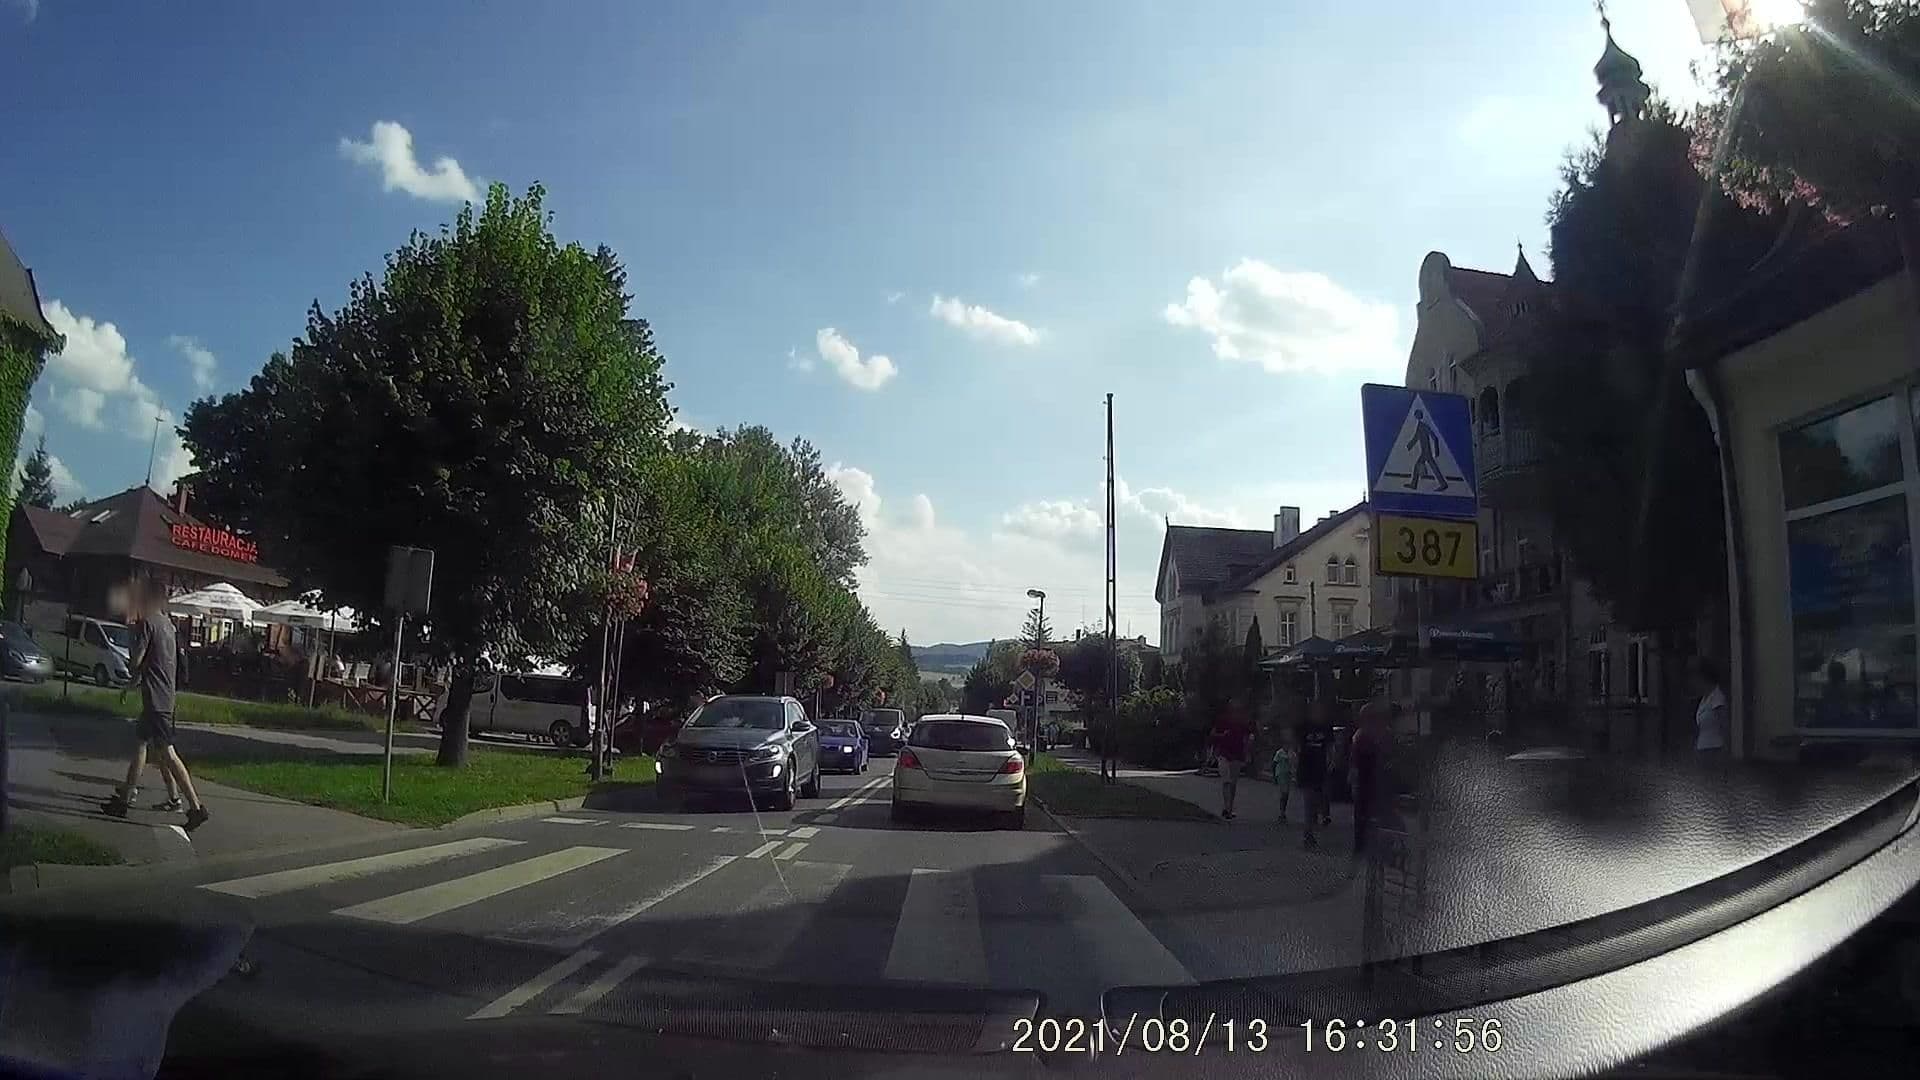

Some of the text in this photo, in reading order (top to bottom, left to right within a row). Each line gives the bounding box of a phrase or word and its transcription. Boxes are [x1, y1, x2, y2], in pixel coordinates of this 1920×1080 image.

[172, 524, 258, 554] RESTAURACJA
[211, 545, 258, 562] DOMEK
[1396, 526, 1461, 566] 387
